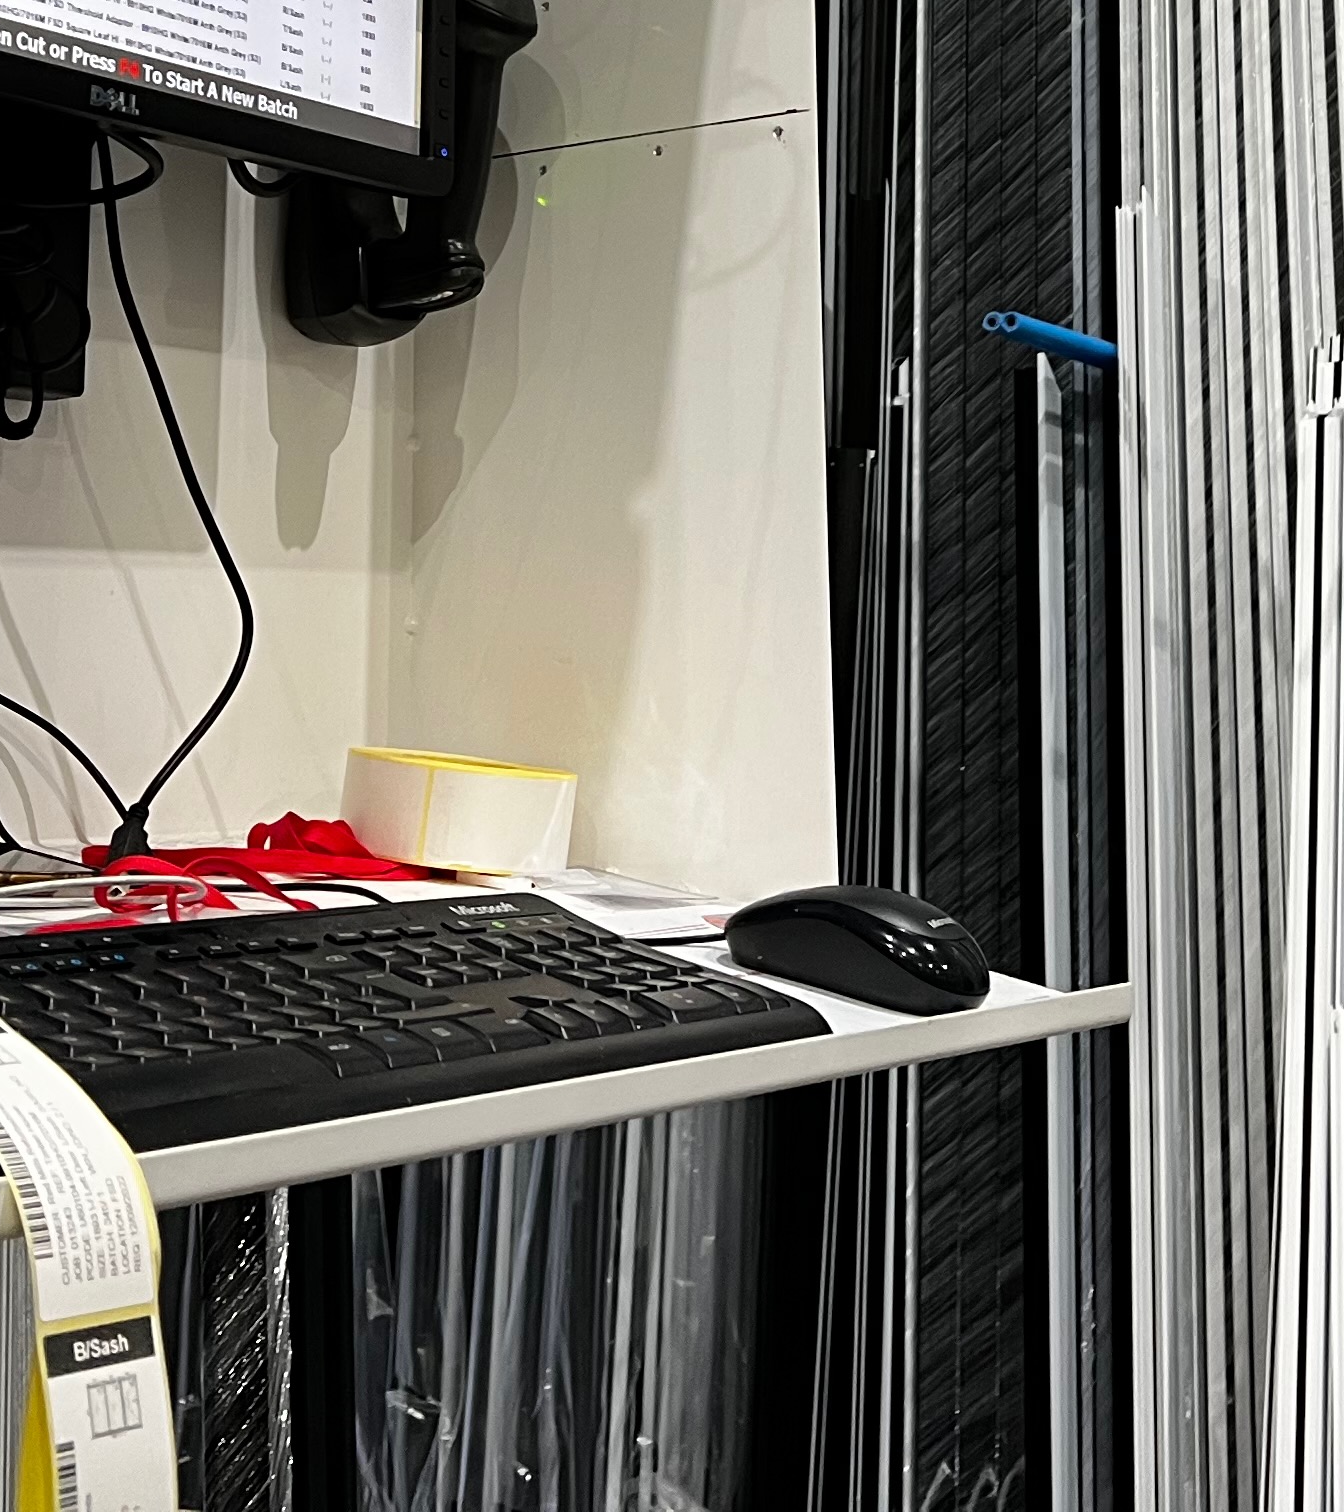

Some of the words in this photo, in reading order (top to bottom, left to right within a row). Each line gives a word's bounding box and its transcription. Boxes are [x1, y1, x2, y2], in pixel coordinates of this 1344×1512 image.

[15, 30, 46, 55] Cut
[49, 42, 69, 61] or
[71, 45, 116, 73] Press
[142, 62, 163, 85] To
[165, 70, 204, 96] Start
[206, 80, 218, 99] A
[221, 85, 254, 108] New
[258, 94, 298, 119] Batch
[90, 85, 139, 116] DELL
[449, 901, 520, 916] Microsoft
[73, 1334, 129, 1362] B/Sash
